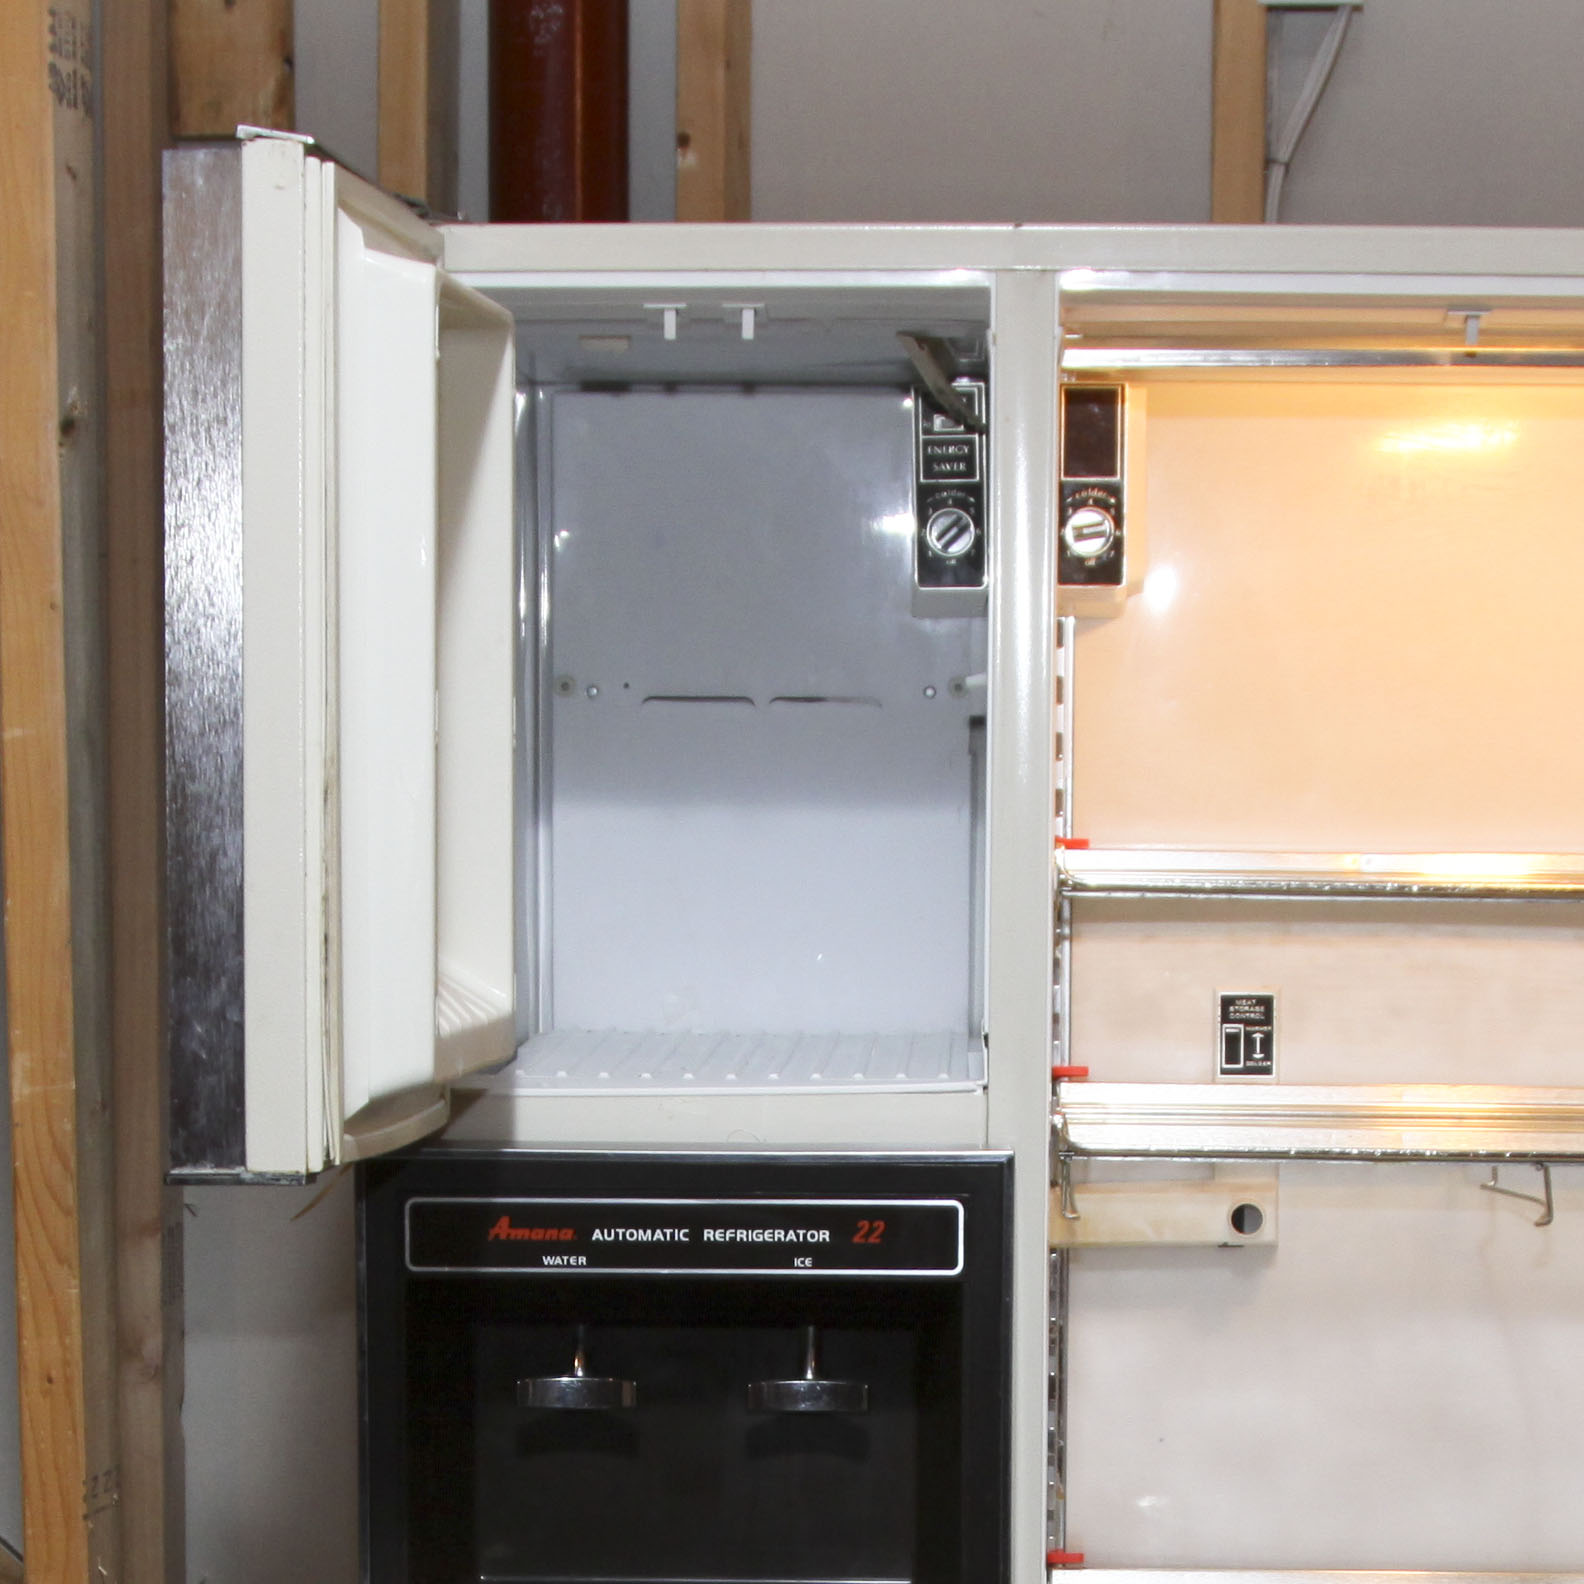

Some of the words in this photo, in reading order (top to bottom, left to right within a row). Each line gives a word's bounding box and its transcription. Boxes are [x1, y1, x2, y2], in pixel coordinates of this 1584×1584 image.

[927, 444, 970, 455] ENERGY
[932, 461, 967, 472] SAVER
[487, 1215, 577, 1243] Amana
[591, 1227, 690, 1243] AUTOMATIC
[703, 1228, 831, 1244] REFRIGERATOR
[851, 1219, 887, 1244] 22
[542, 1254, 587, 1267] WATER
[793, 1256, 813, 1268] ICE
